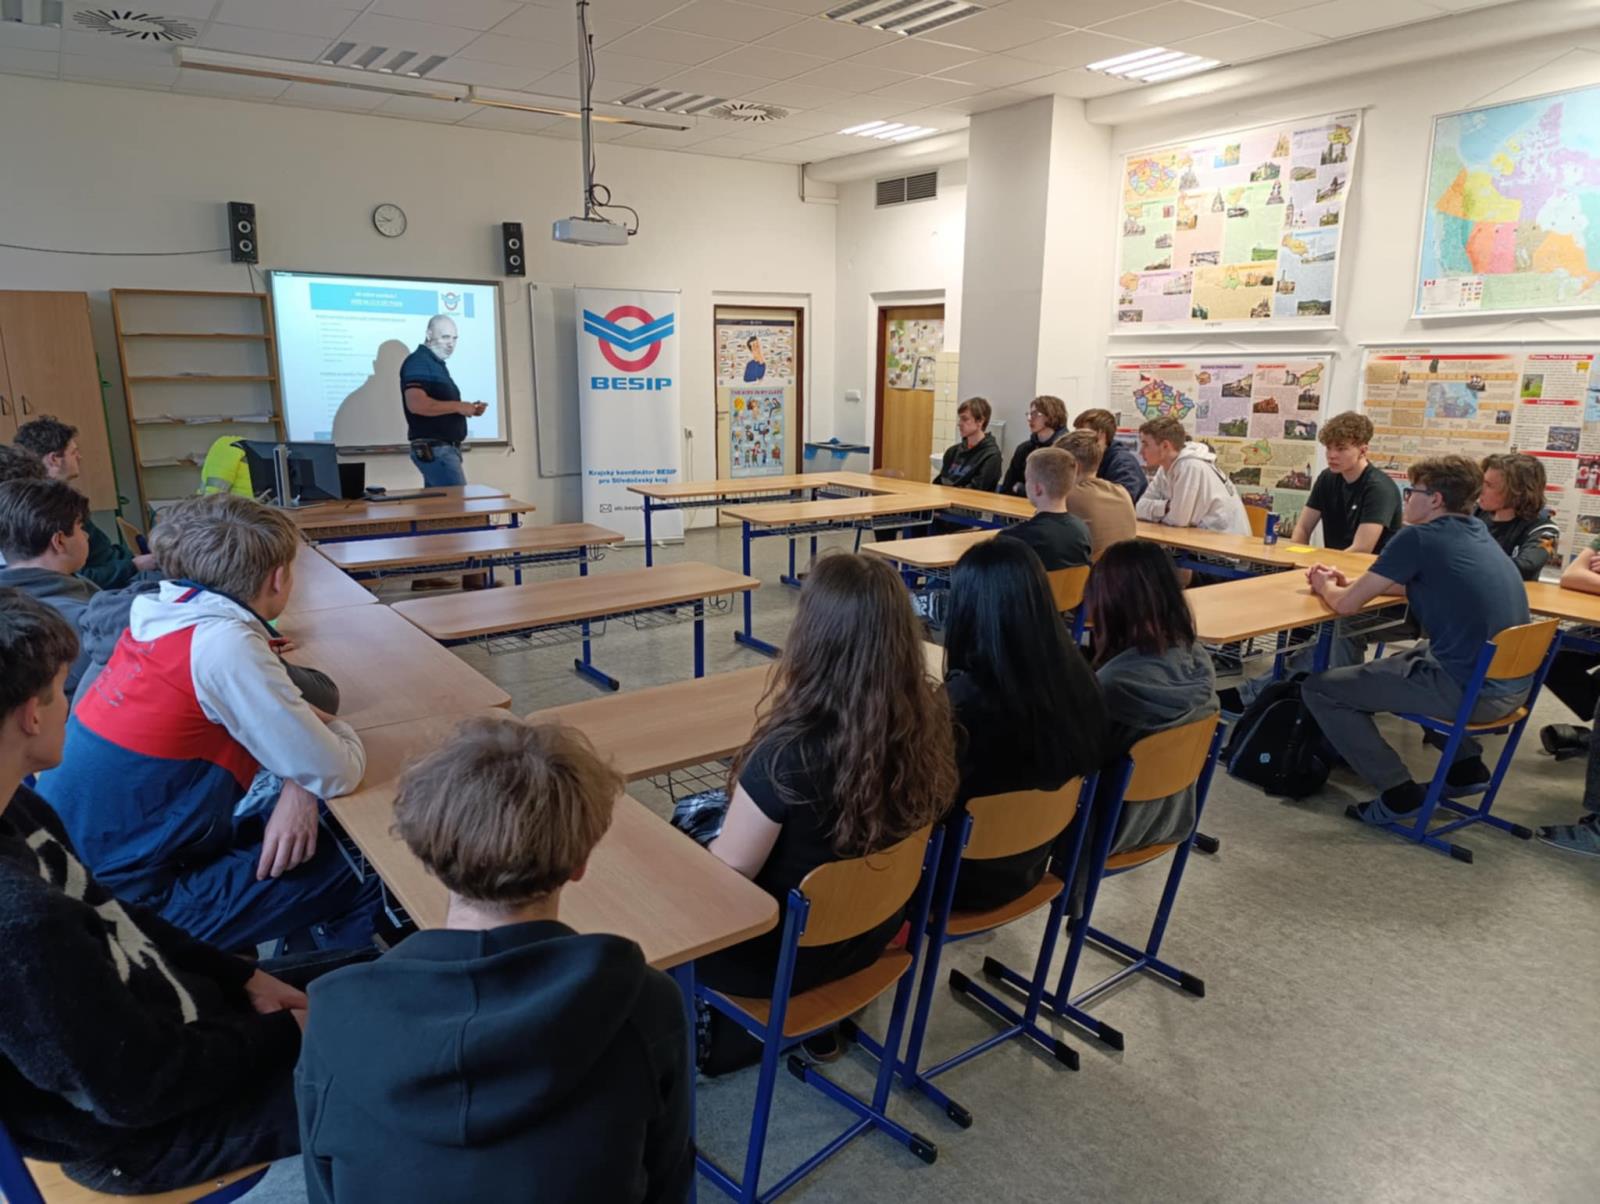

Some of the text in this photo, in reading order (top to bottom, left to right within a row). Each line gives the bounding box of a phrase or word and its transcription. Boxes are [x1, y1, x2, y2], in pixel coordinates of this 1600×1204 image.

[591, 376, 672, 391] BESIP
[588, 469, 614, 477] Krajský
[656, 468, 677, 476] BESIP
[655, 477, 668, 485] kraj
